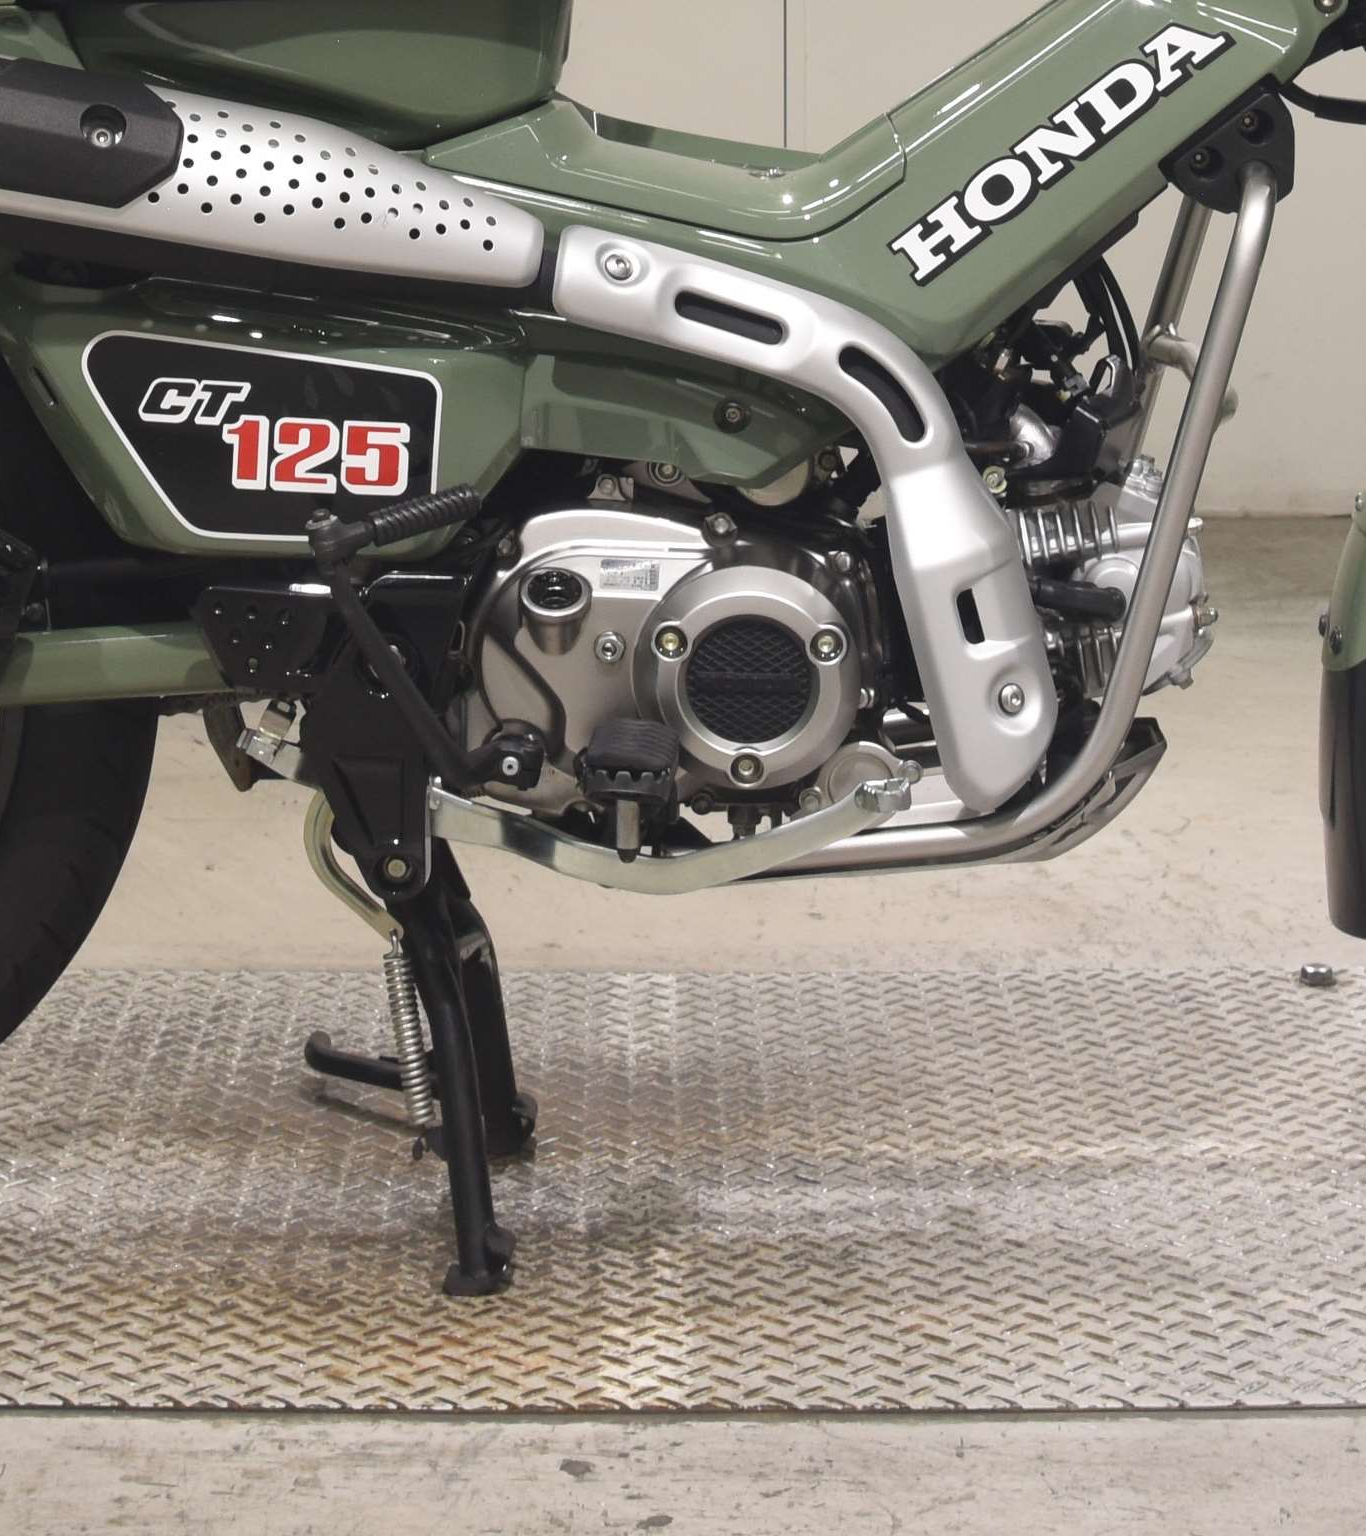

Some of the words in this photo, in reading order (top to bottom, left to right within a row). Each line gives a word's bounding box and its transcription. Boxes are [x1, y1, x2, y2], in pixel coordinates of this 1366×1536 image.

[887, 23, 1235, 286] HONDA
[139, 377, 251, 425] CT
[222, 414, 410, 496] 125
